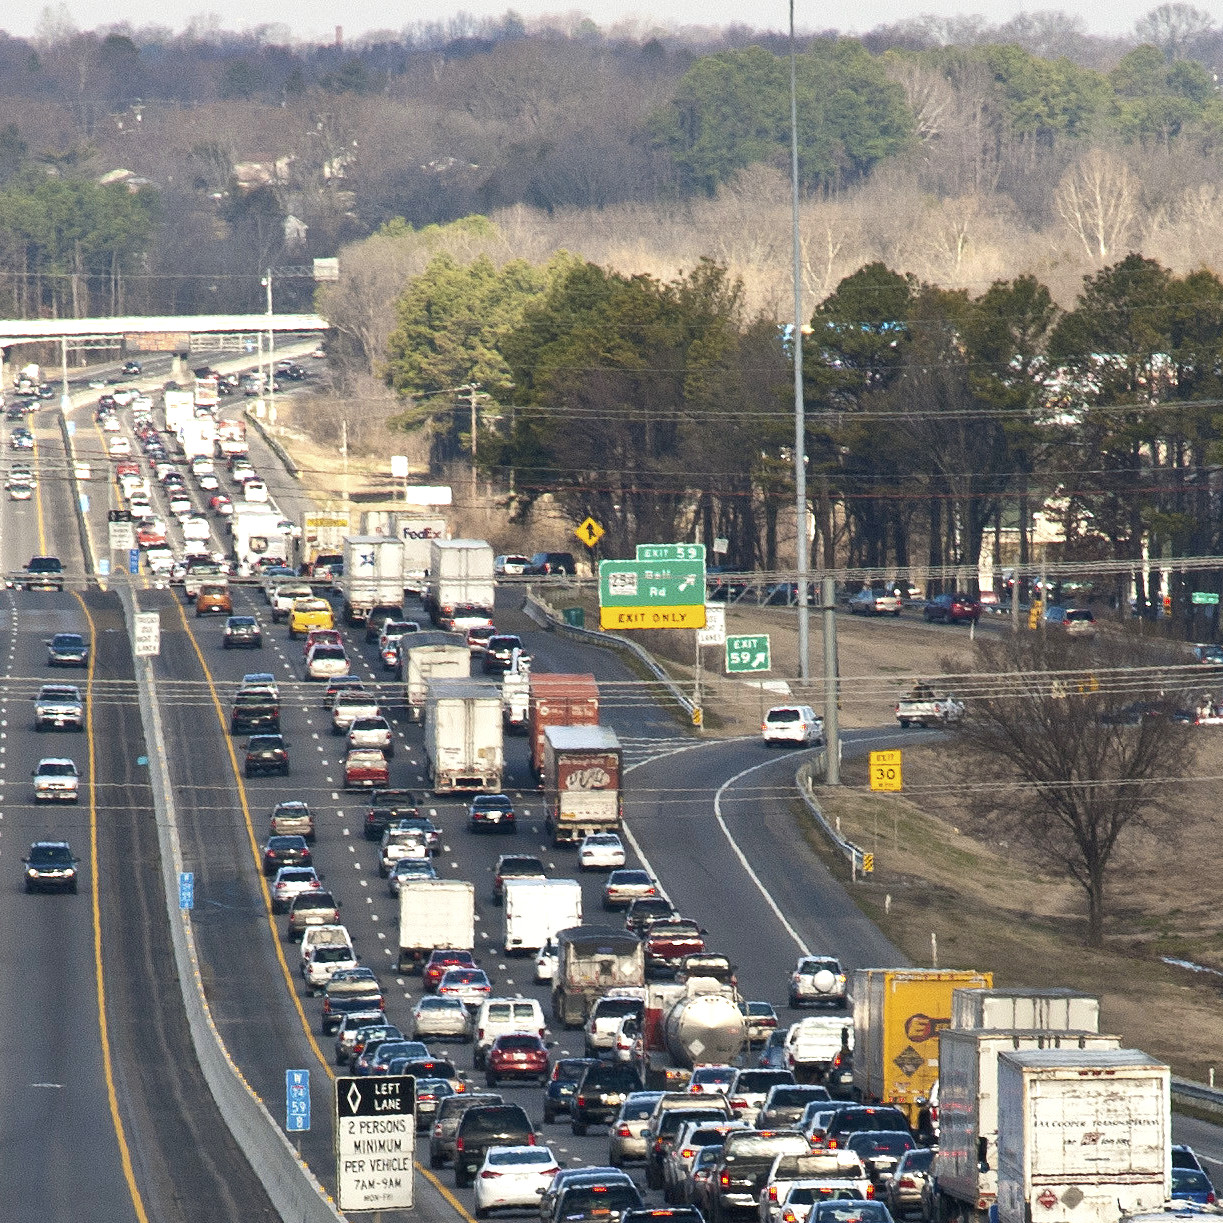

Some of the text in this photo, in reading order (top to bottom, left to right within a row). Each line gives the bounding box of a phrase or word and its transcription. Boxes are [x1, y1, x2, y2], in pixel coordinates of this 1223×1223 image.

[403, 527, 441, 540] FedEx
[644, 547, 697, 559] EXIT 59
[650, 587, 667, 597] Rd
[618, 612, 687, 623] EXIT ONLY
[734, 639, 758, 650] EXIT
[730, 652, 751, 665] 59
[876, 768, 895, 780] 30
[374, 1083, 401, 1095] LEFT
[291, 1101, 307, 1113] 59
[374, 1099, 401, 1111] LANE
[348, 1119, 406, 1134] 2 PERSONS
[353, 1139, 402, 1154] MINIMUM
[344, 1158, 408, 1173] PER VEHICLE
[353, 1178, 401, 1190] 7AM-9AM
